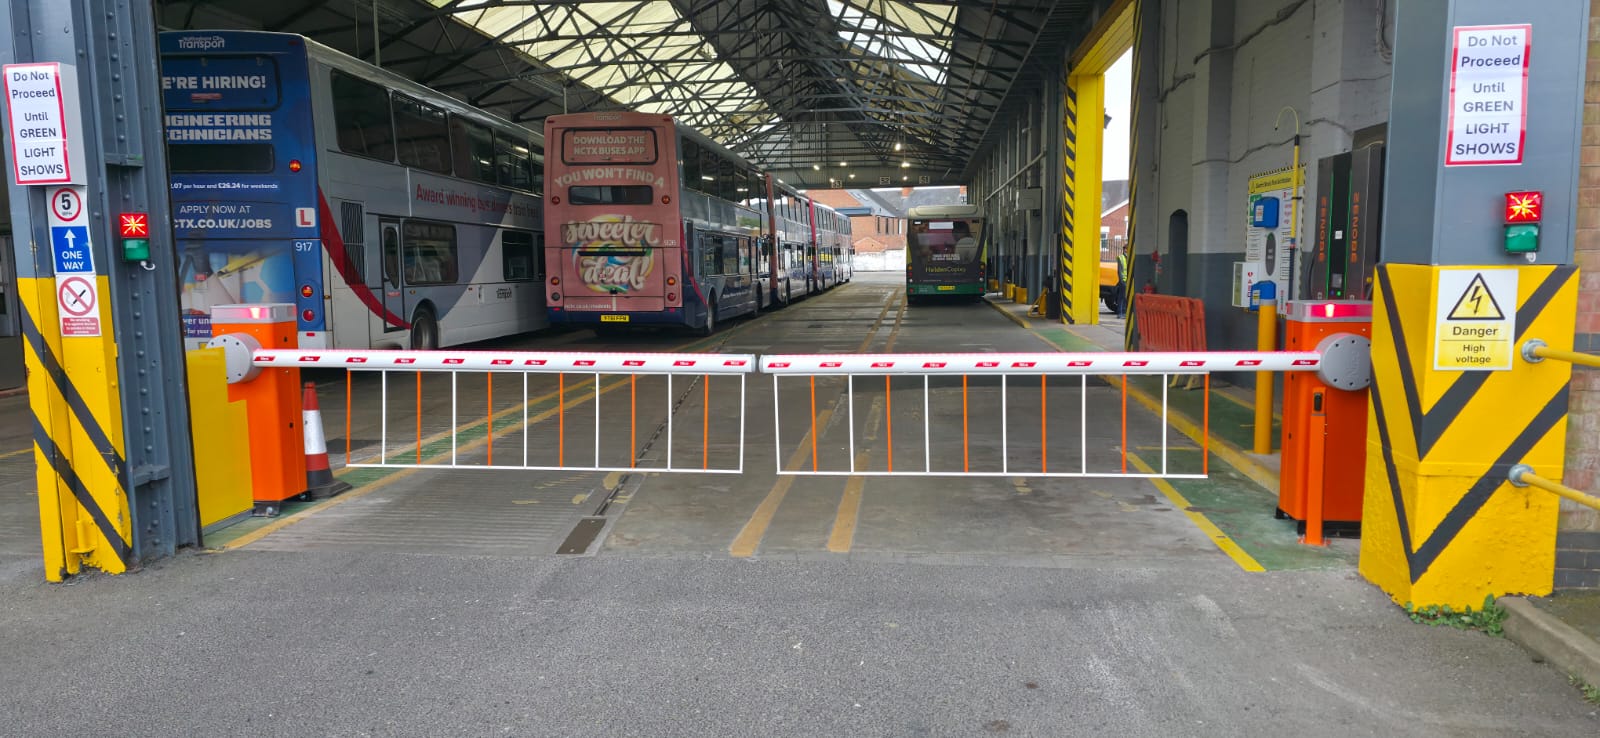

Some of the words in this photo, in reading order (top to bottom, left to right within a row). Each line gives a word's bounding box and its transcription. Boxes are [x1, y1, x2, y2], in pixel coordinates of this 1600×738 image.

[178, 39, 226, 50] Transport
[1468, 36, 1488, 47] Do
[1491, 35, 1518, 46] Not
[1461, 55, 1521, 67] Proceed
[13, 72, 28, 82] Do
[30, 71, 49, 81] Not
[202, 76, 266, 89] HIRING!
[1473, 82, 1505, 93] Until
[12, 88, 55, 99] Proceed
[1463, 100, 1514, 112] GREEN
[24, 112, 49, 121] Until
[20, 128, 57, 138] GREEN
[1466, 122, 1510, 134] LIGHT
[167, 129, 272, 140] CHNICIANS
[573, 136, 626, 145] DOWNLOAD
[627, 136, 645, 144] THE
[24, 147, 56, 158] LIGHT
[574, 147, 597, 155] NCTX
[599, 147, 626, 155] BUSES
[1455, 142, 1516, 155] SHOWS
[20, 164, 64, 175] SHOWS
[554, 171, 581, 188] YOU
[582, 168, 624, 181] WON'T
[626, 168, 654, 183] FIND
[654, 177, 665, 188] A
[61, 193, 71, 211] 5
[416, 184, 444, 206] Award
[446, 191, 477, 213] winning
[180, 206, 209, 214] APPLY
[212, 206, 236, 214] NOW
[239, 206, 251, 214] AT
[300, 210, 311, 226] L
[566, 216, 659, 246] sweeter
[295, 242, 313, 252] 917
[62, 251, 83, 260] ONE
[63, 262, 84, 270] WAY
[582, 253, 649, 290] deal!
[1452, 326, 1499, 338] Danger
[1463, 344, 1486, 354] High
[1456, 356, 1491, 365] voltage
